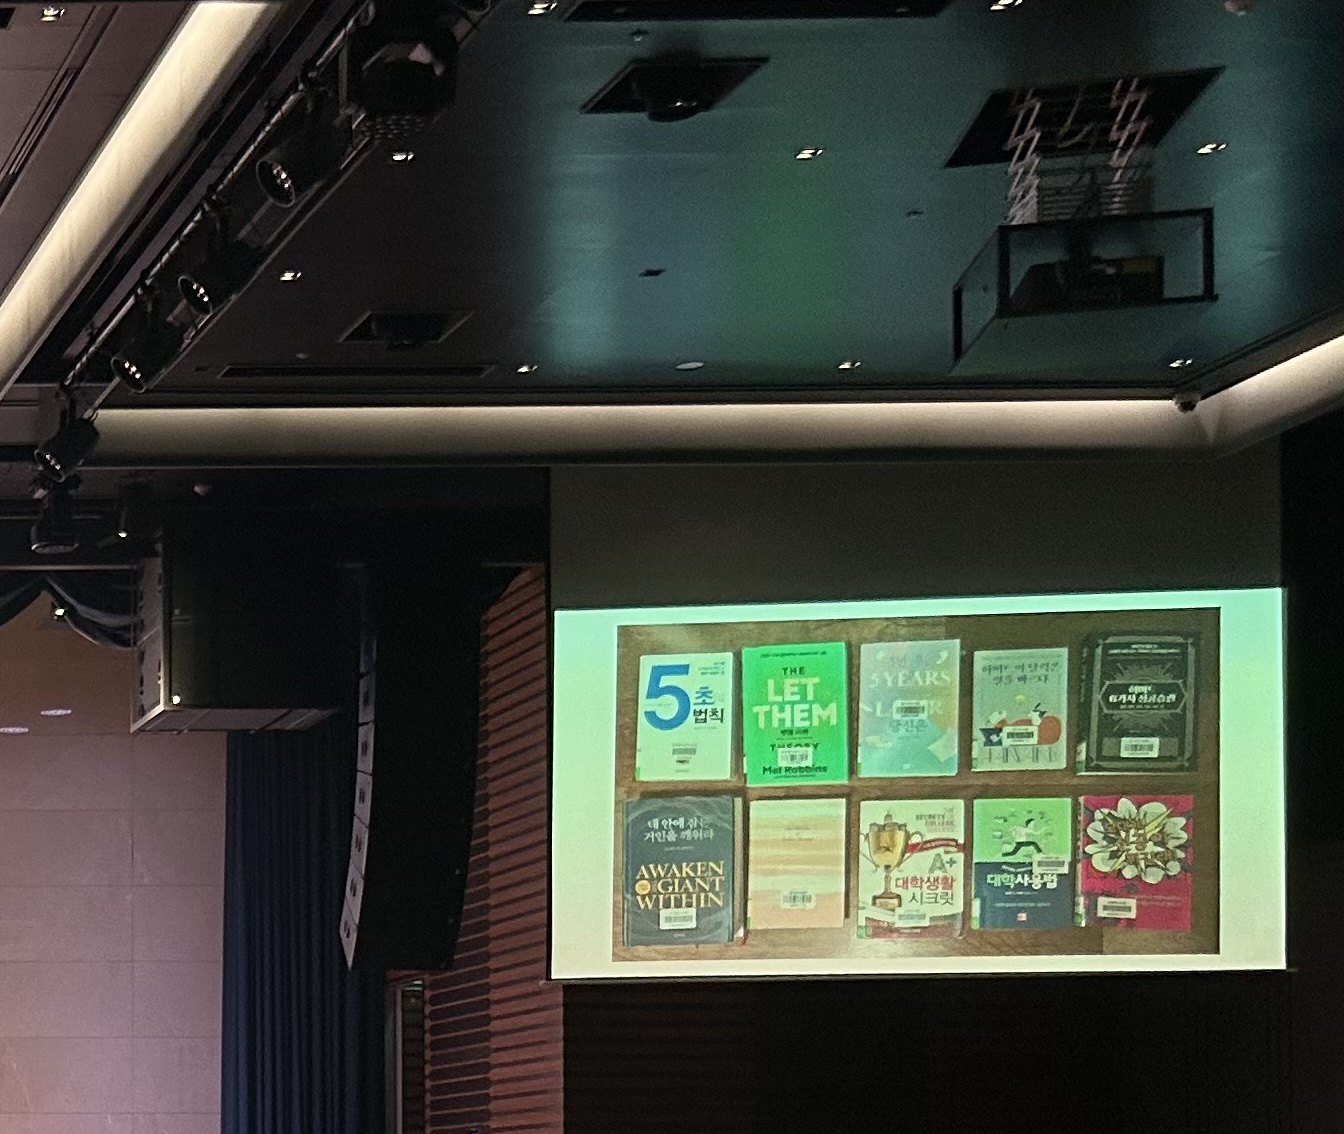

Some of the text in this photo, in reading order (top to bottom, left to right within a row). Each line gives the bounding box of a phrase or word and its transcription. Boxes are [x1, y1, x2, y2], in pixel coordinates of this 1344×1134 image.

[782, 666, 805, 675] THE
[644, 664, 691, 730] 5
[767, 677, 820, 702] LET
[752, 702, 837, 729] THEM
[635, 860, 725, 880] AWAKEN
[657, 876, 725, 894] GIANT
[636, 892, 724, 910] WITHIN
[908, 891, 954, 906] 시크릿
